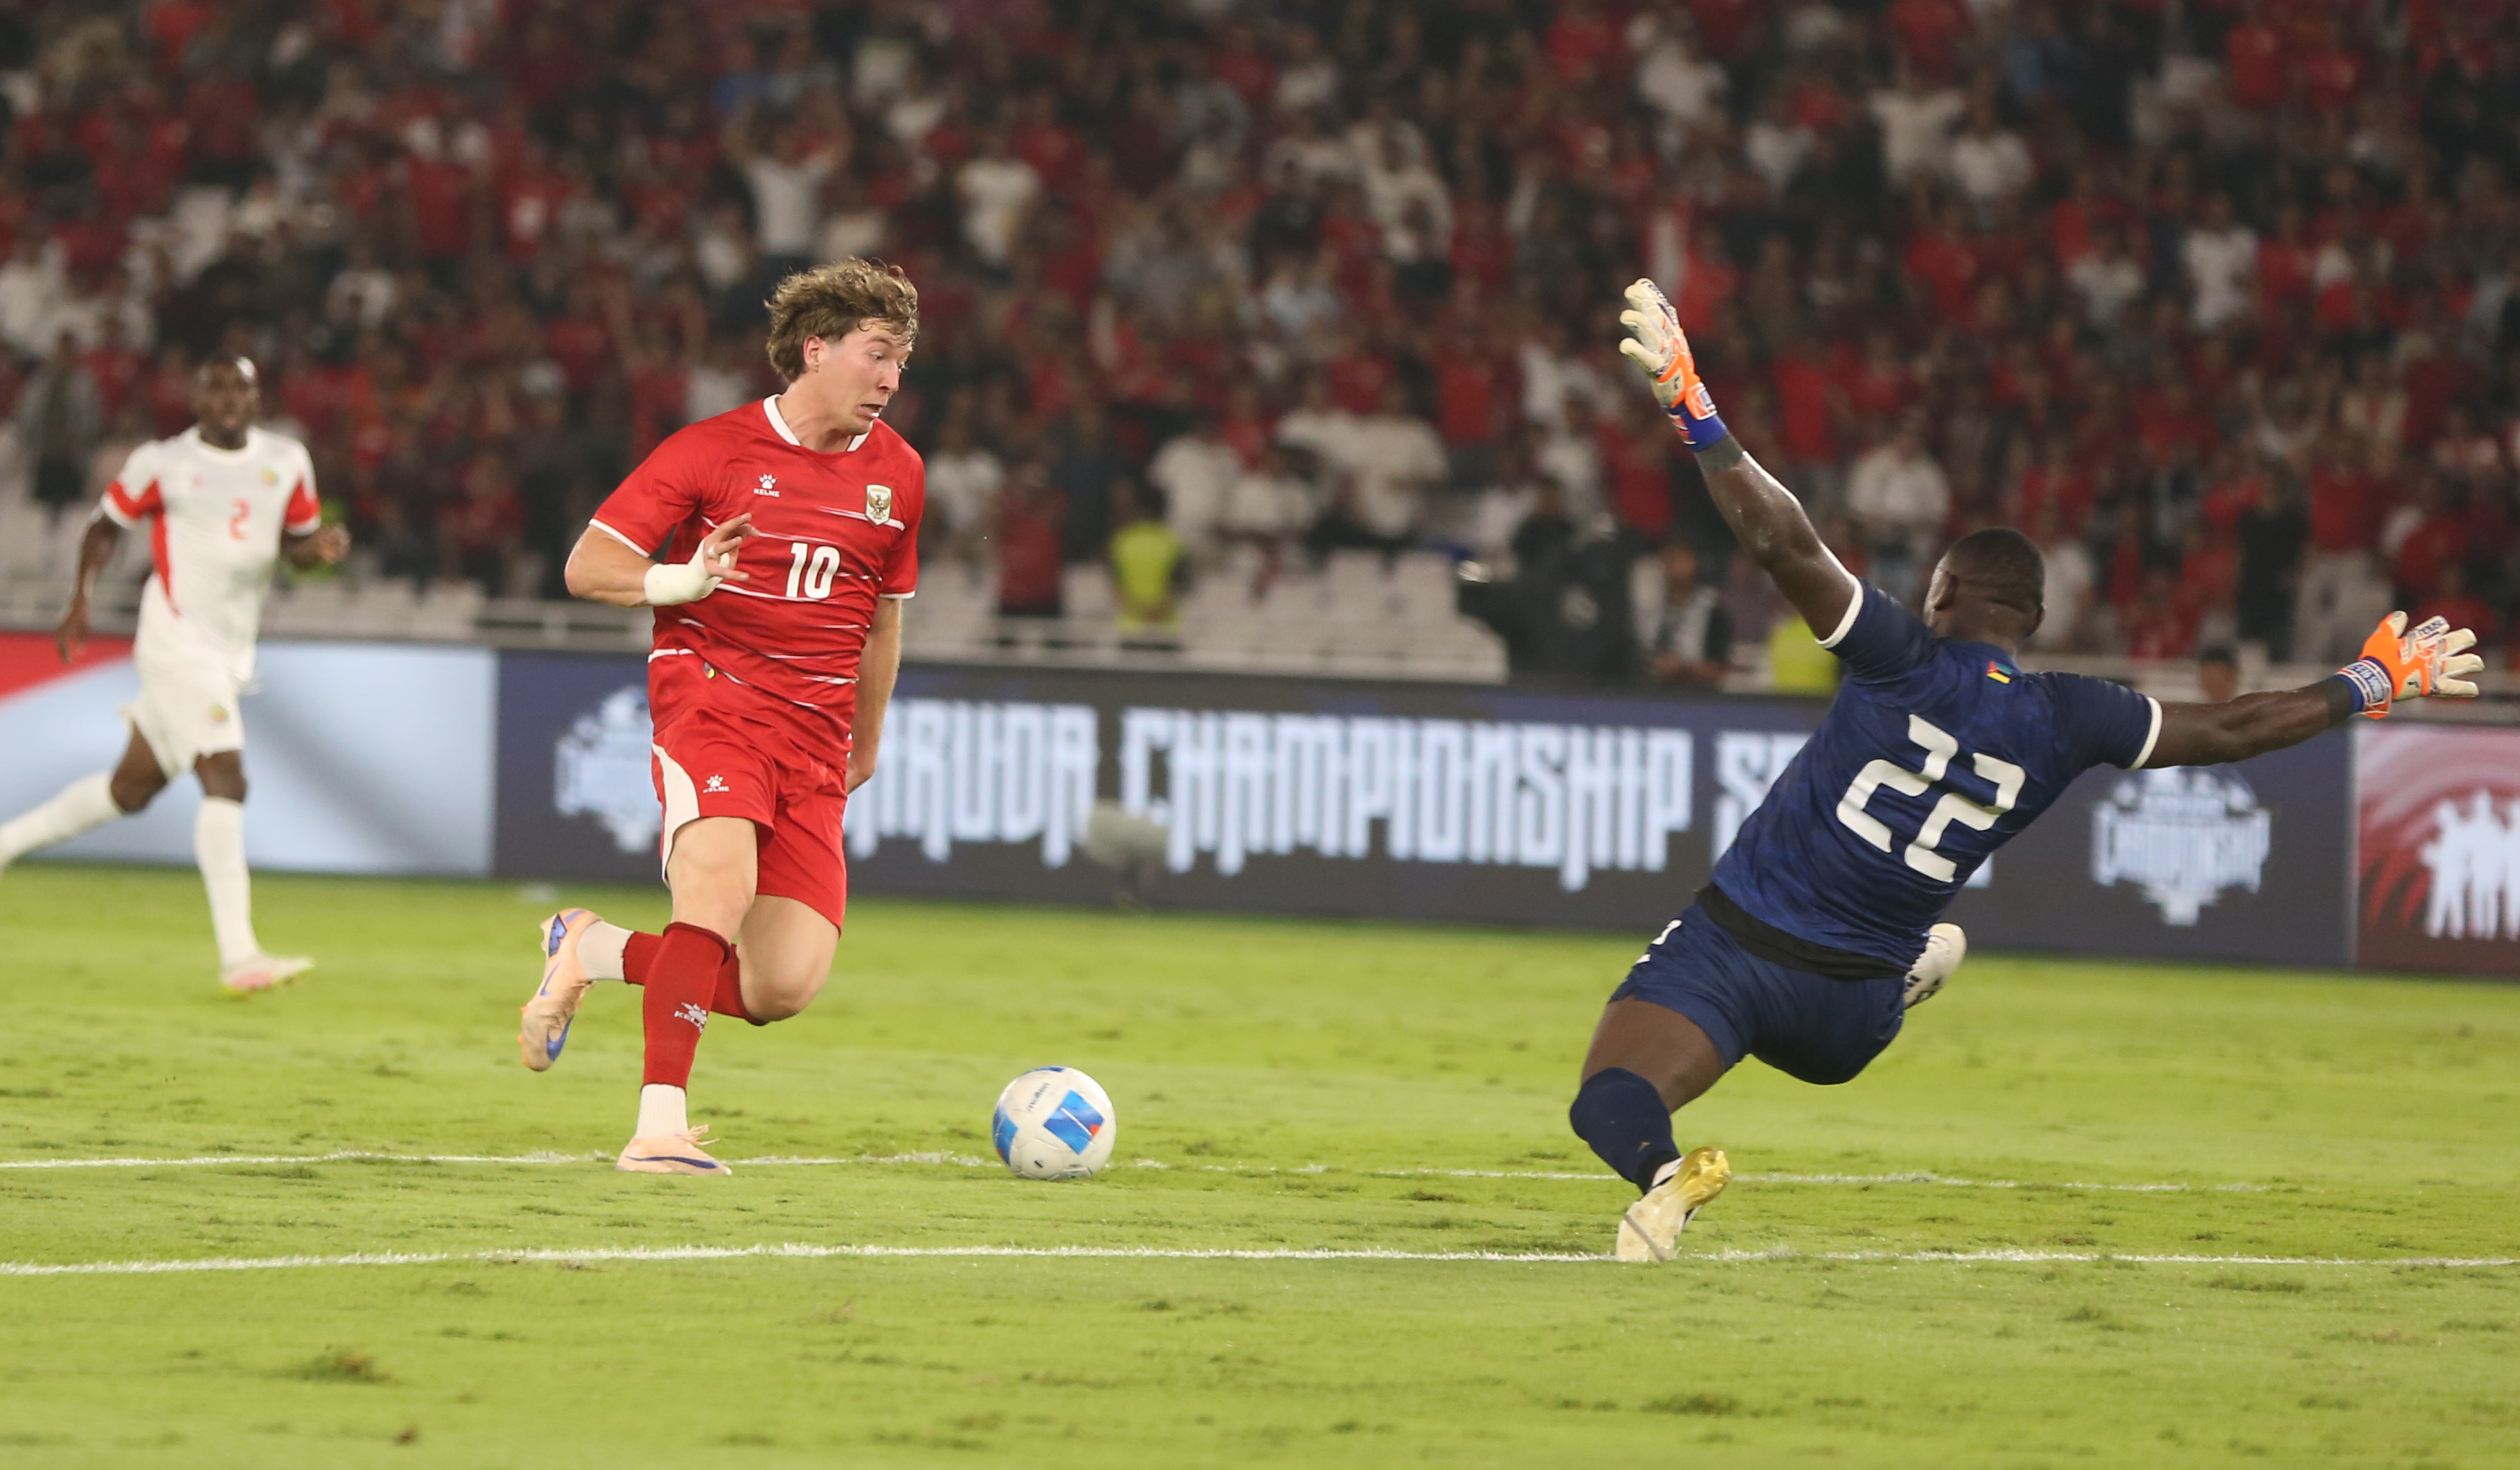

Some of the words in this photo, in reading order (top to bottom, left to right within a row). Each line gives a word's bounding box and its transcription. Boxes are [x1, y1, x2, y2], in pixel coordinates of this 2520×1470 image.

[229, 497, 251, 541] 2
[753, 487, 780, 498] KELME
[785, 542, 841, 599] 10
[843, 696, 1100, 868] ARUDA
[1120, 705, 1693, 892] CHAMPIONSHIP
[1836, 713, 2026, 883] 22
